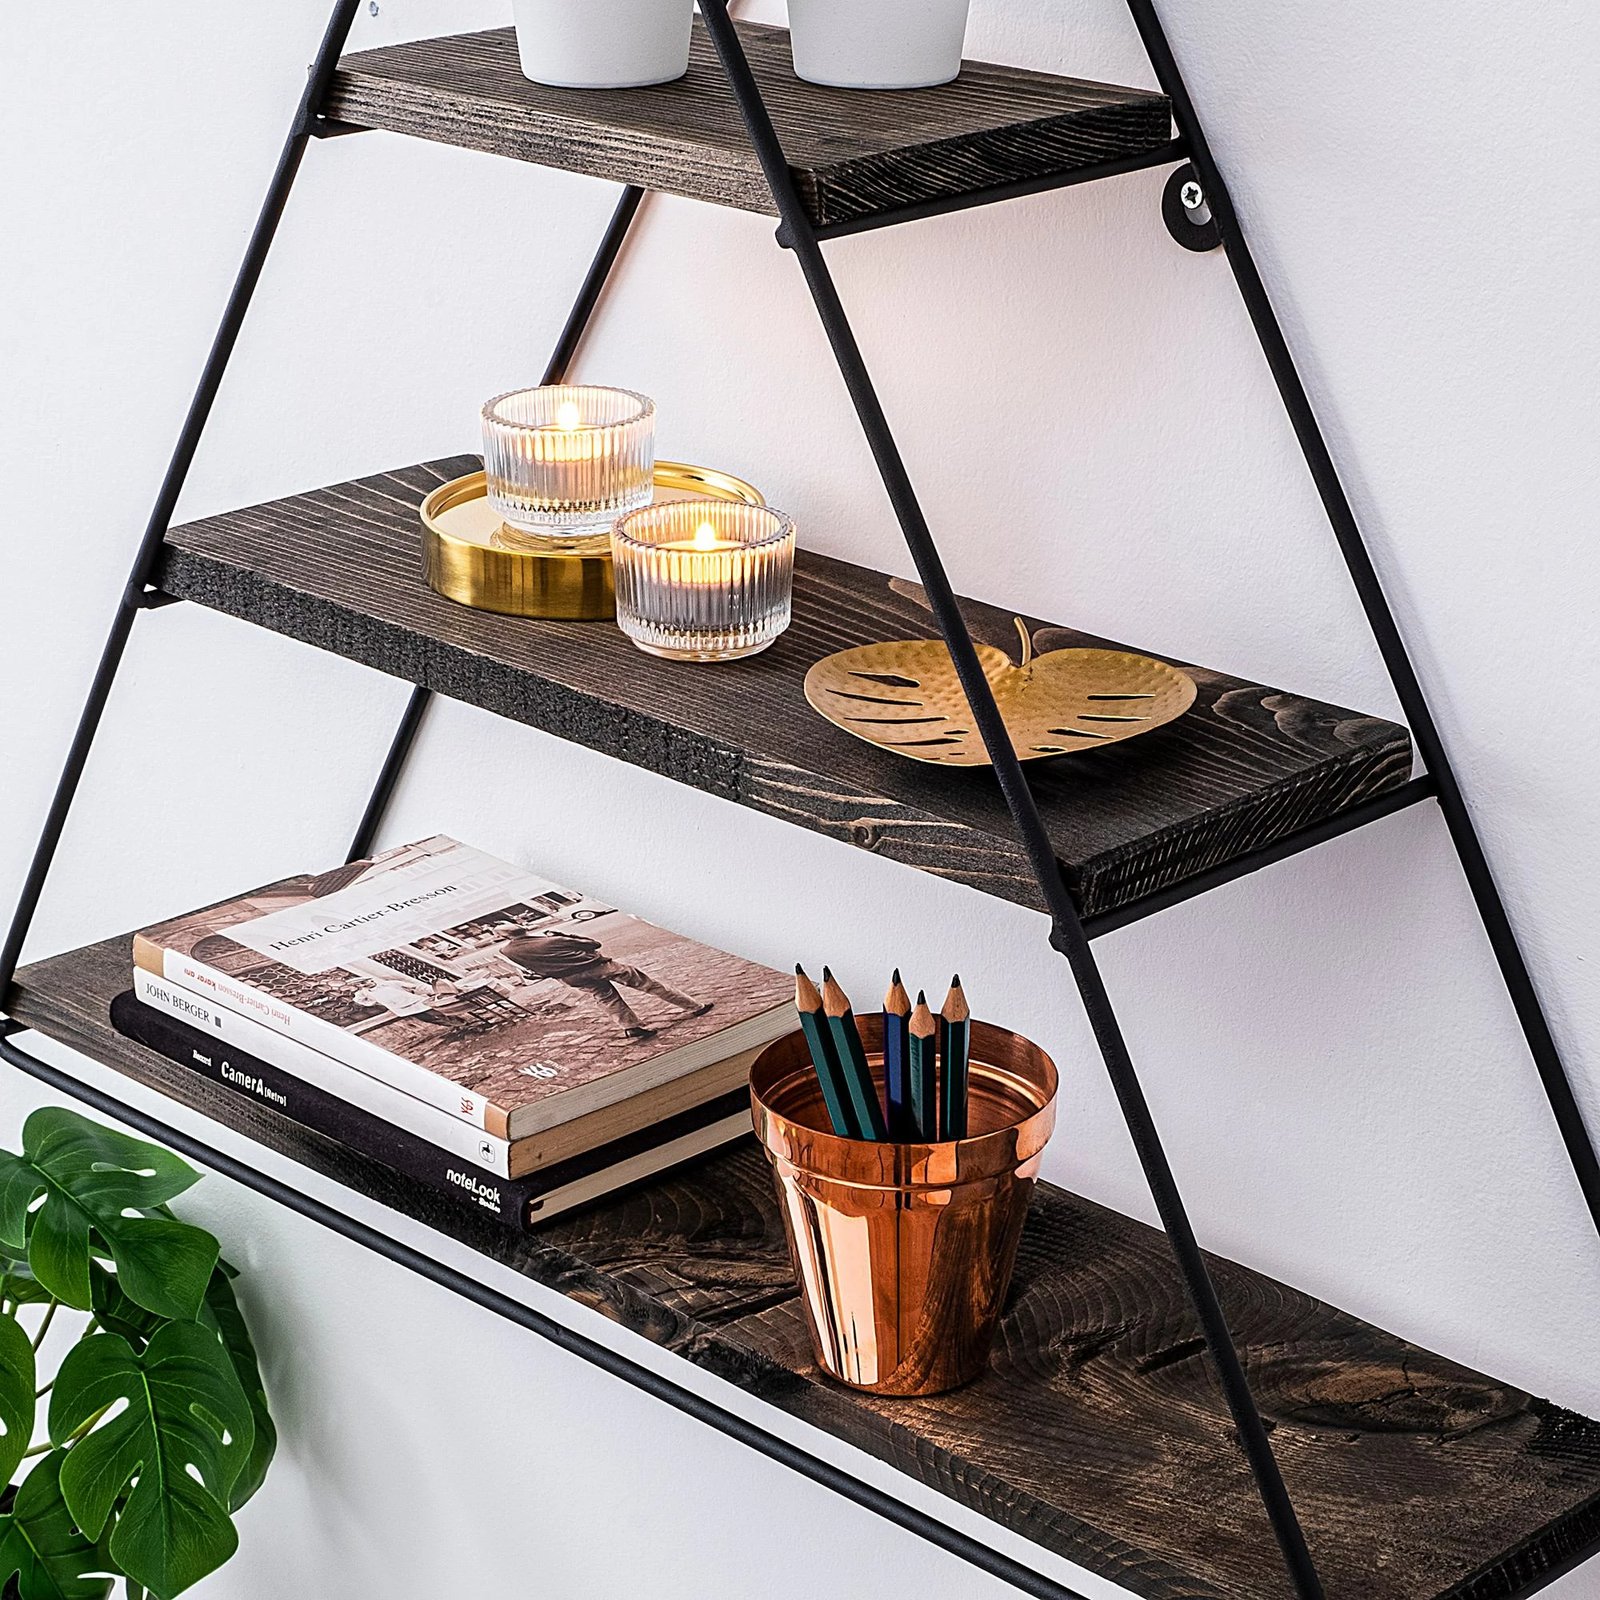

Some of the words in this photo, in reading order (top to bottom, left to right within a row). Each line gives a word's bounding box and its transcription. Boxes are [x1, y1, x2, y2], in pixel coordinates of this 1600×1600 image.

[269, 931, 323, 951] Henri
[323, 884, 458, 934] Cartier-Bresson
[146, 983, 171, 1003] JOHN
[172, 995, 211, 1023] BERGER
[217, 984, 270, 1016] Cartier-Bresson
[271, 1009, 291, 1026] Henri
[446, 1169, 501, 1204] noteLook
